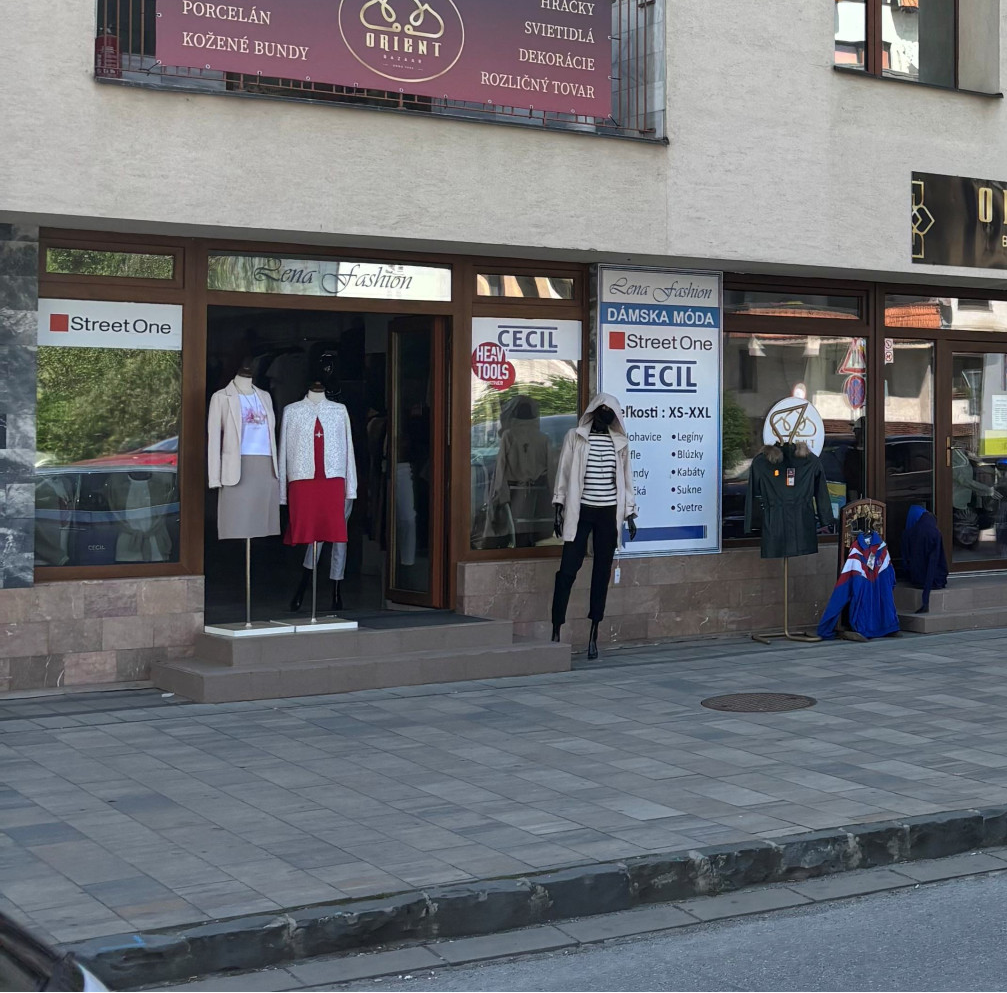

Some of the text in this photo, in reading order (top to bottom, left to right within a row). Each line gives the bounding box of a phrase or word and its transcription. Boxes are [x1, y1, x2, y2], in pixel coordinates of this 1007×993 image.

[182, 0, 272, 25] PORCELÁN
[524, 20, 595, 44] SVIETIDLÁ
[182, 31, 309, 61] KOŽENÉ BUNDY
[365, 32, 442, 57] ORIENT
[518, 48, 595, 71] DEKORÁCIE
[480, 71, 595, 99] ROZLIČNÝ TOVAR
[254, 257, 413, 294] Lena Fashion
[609, 276, 713, 303] Lena Fashion
[607, 305, 715, 325] DÁMSKA MÓDA
[70, 316, 172, 335] Street One
[497, 329, 558, 349] CECIL
[626, 333, 713, 351] Street One
[475, 363, 509, 380] TOOLS
[626, 364, 698, 388] CECIL
[621, 405, 658, 419] eľkosti
[668, 406, 712, 419] XS-XXL
[626, 432, 662, 442] ohavice
[677, 432, 704, 444] Legíny
[630, 449, 641, 460] fle
[677, 449, 704, 461] Blúzky
[633, 468, 650, 479] ndy
[677, 467, 705, 479] Kabáty
[676, 485, 702, 495] Sukne
[676, 502, 703, 513] Svetre
